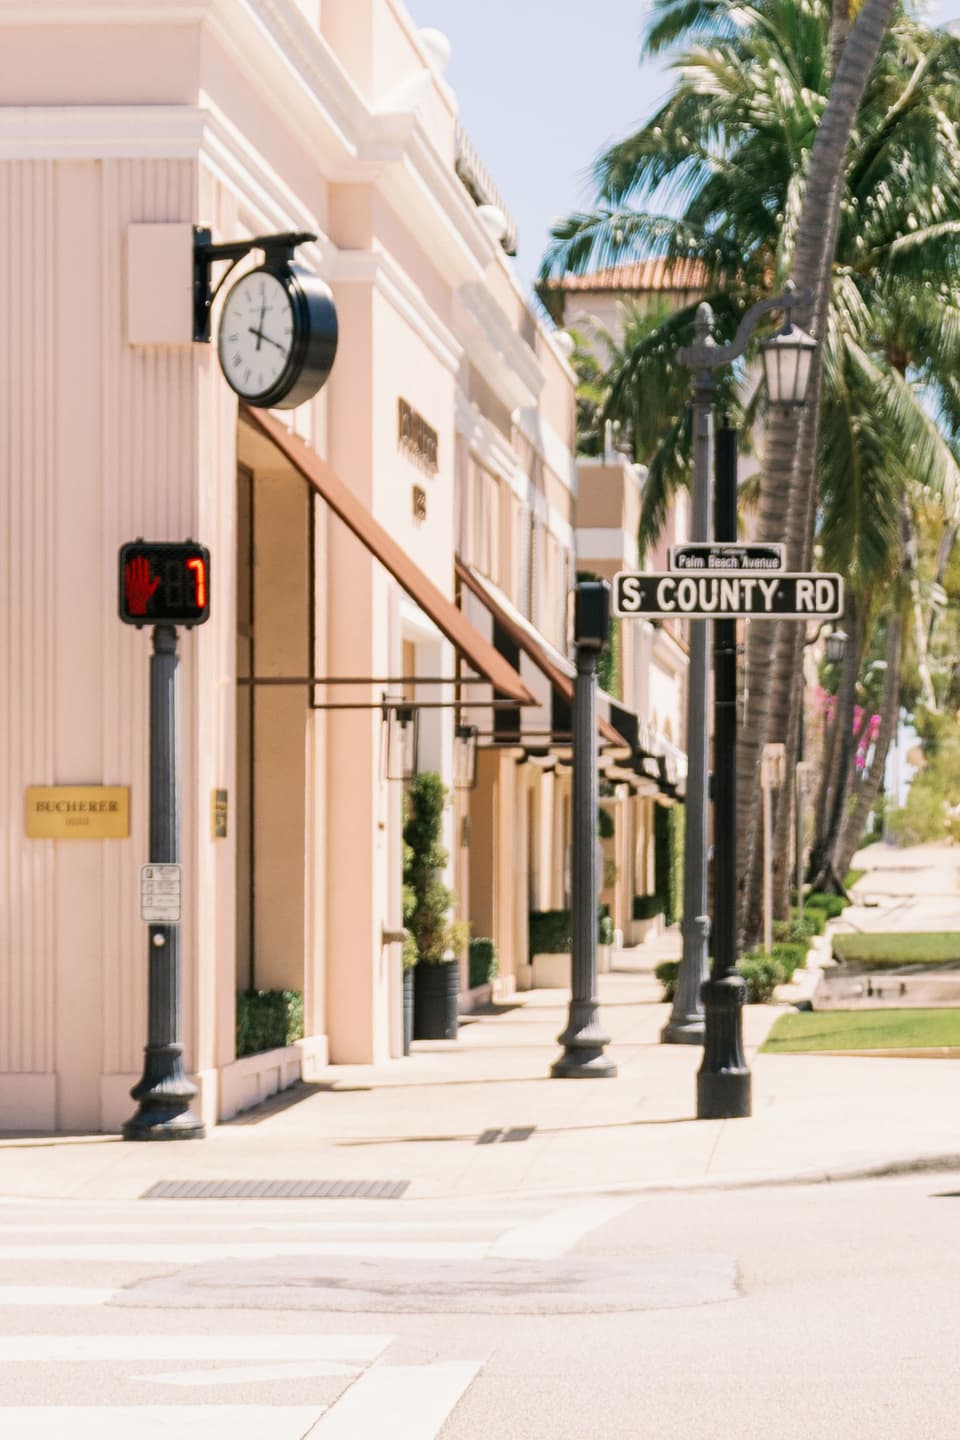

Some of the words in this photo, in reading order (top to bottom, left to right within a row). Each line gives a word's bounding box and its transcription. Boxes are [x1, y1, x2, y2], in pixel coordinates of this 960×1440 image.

[678, 554, 705, 568] Palm
[707, 554, 738, 568] Beach
[741, 555, 779, 568] Avenue
[622, 577, 640, 611] S
[656, 578, 780, 611] COUNTY
[795, 578, 835, 611] RD
[35, 800, 119, 812] BUCHERER
